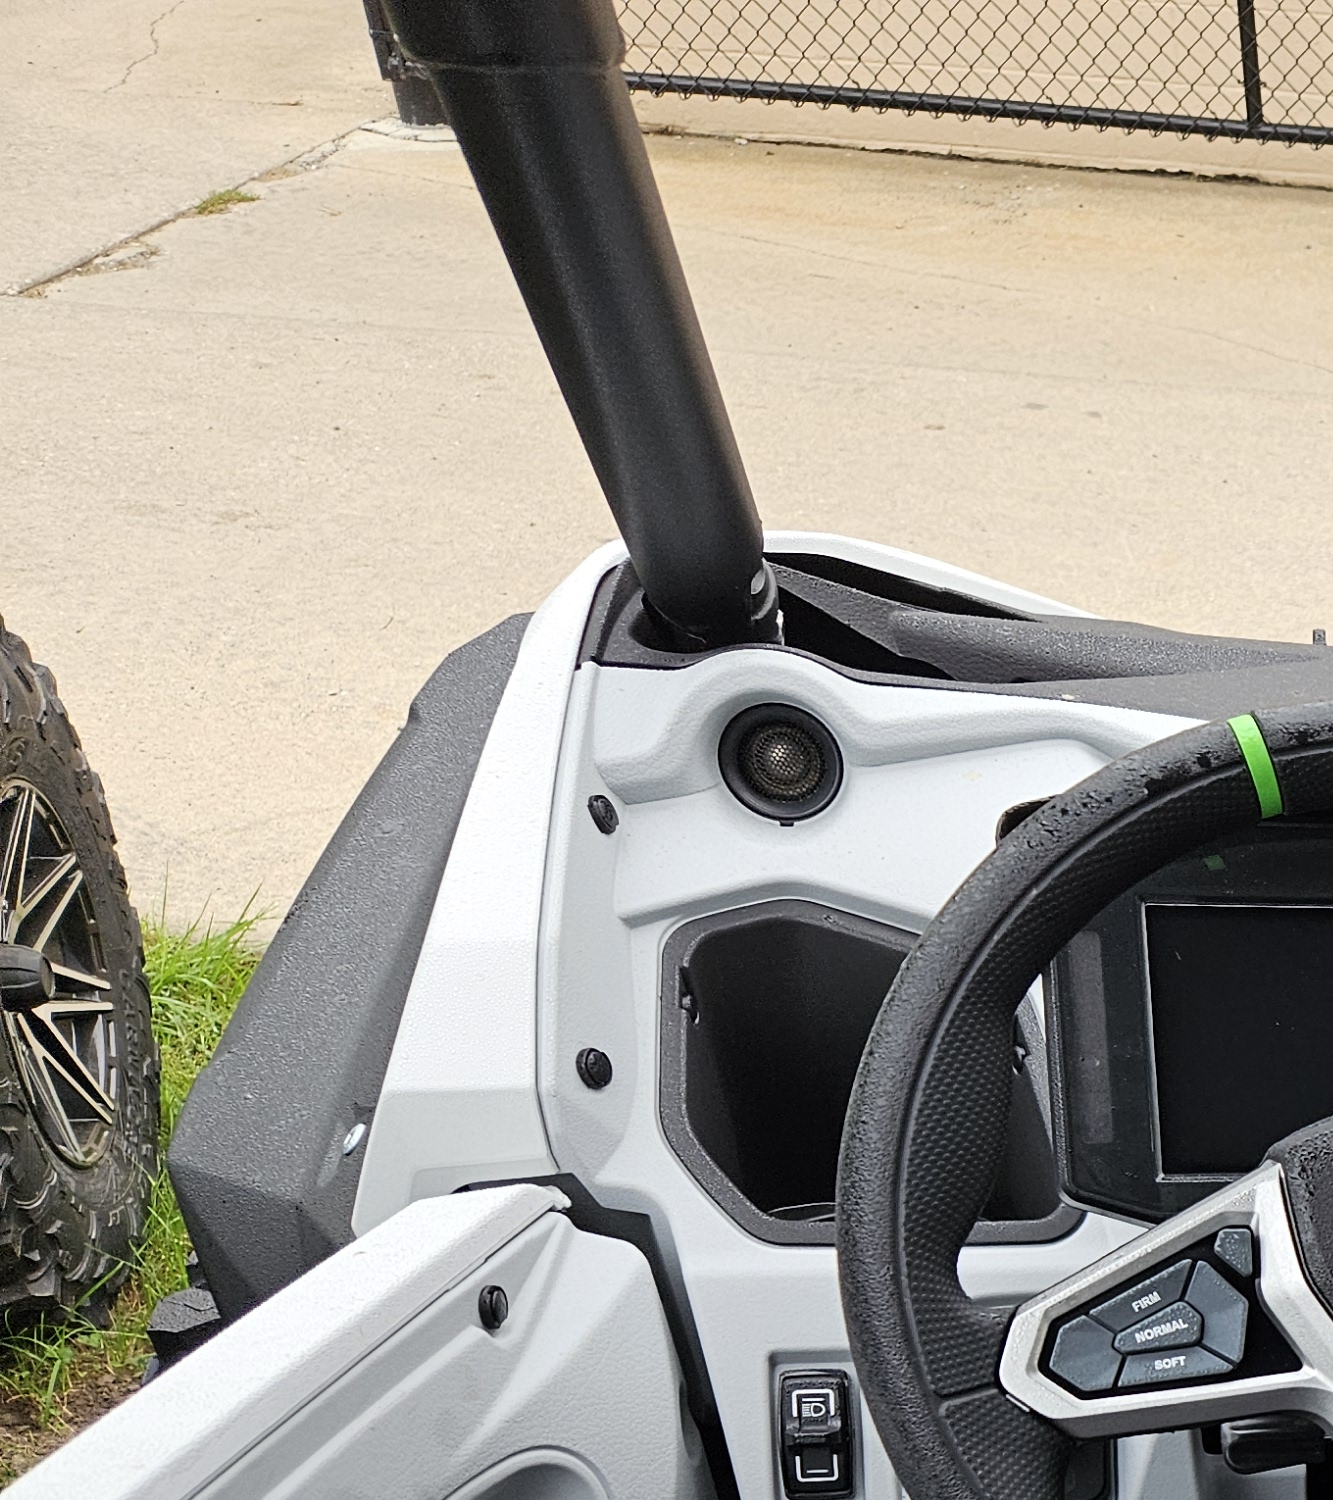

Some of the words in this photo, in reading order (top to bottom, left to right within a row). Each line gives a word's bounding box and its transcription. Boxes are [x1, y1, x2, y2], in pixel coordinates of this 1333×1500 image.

[1131, 1291, 1162, 1313] FIRM
[1134, 1318, 1189, 1343] NORMAL
[1154, 1355, 1186, 1370] SOFT
